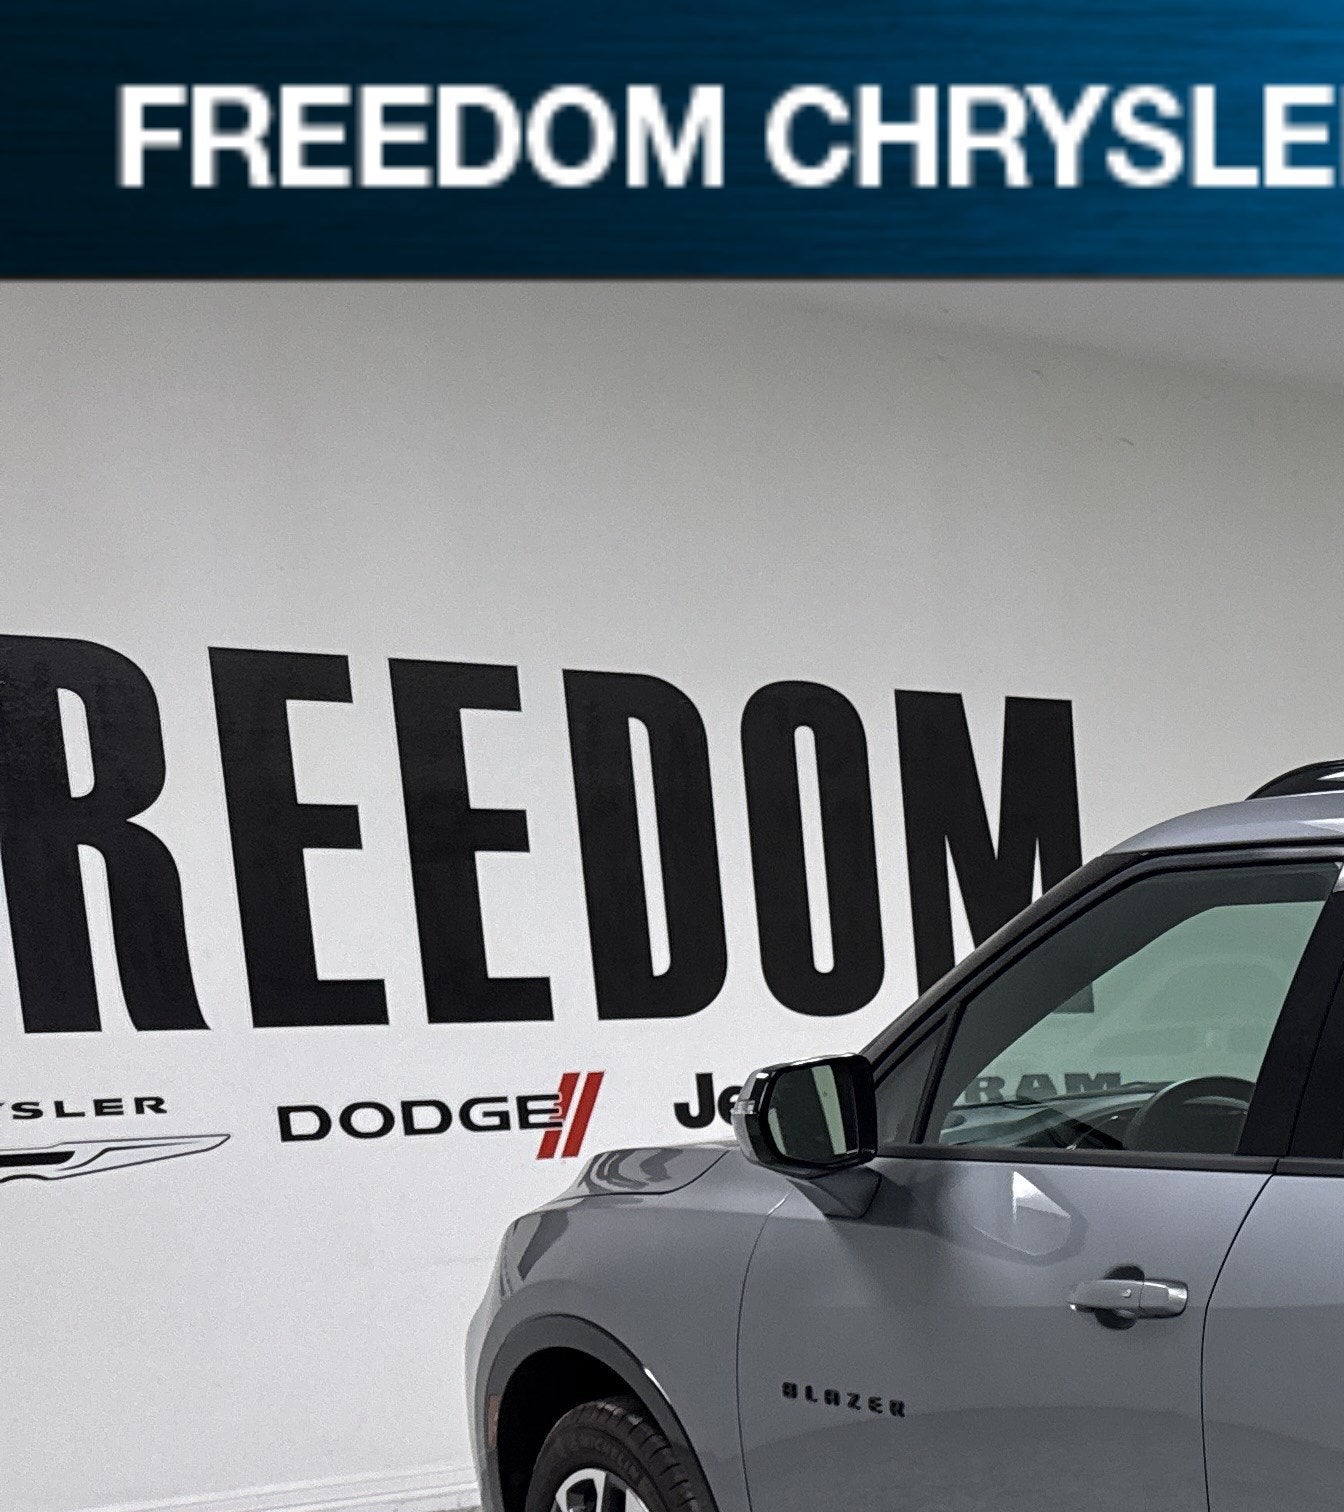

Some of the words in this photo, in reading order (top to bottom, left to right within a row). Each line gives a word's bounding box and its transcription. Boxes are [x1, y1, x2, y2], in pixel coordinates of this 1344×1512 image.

[0, 1096, 168, 1120] SLER
[276, 1093, 564, 1143] DODGE
[782, 1381, 906, 1418] BLAZER
